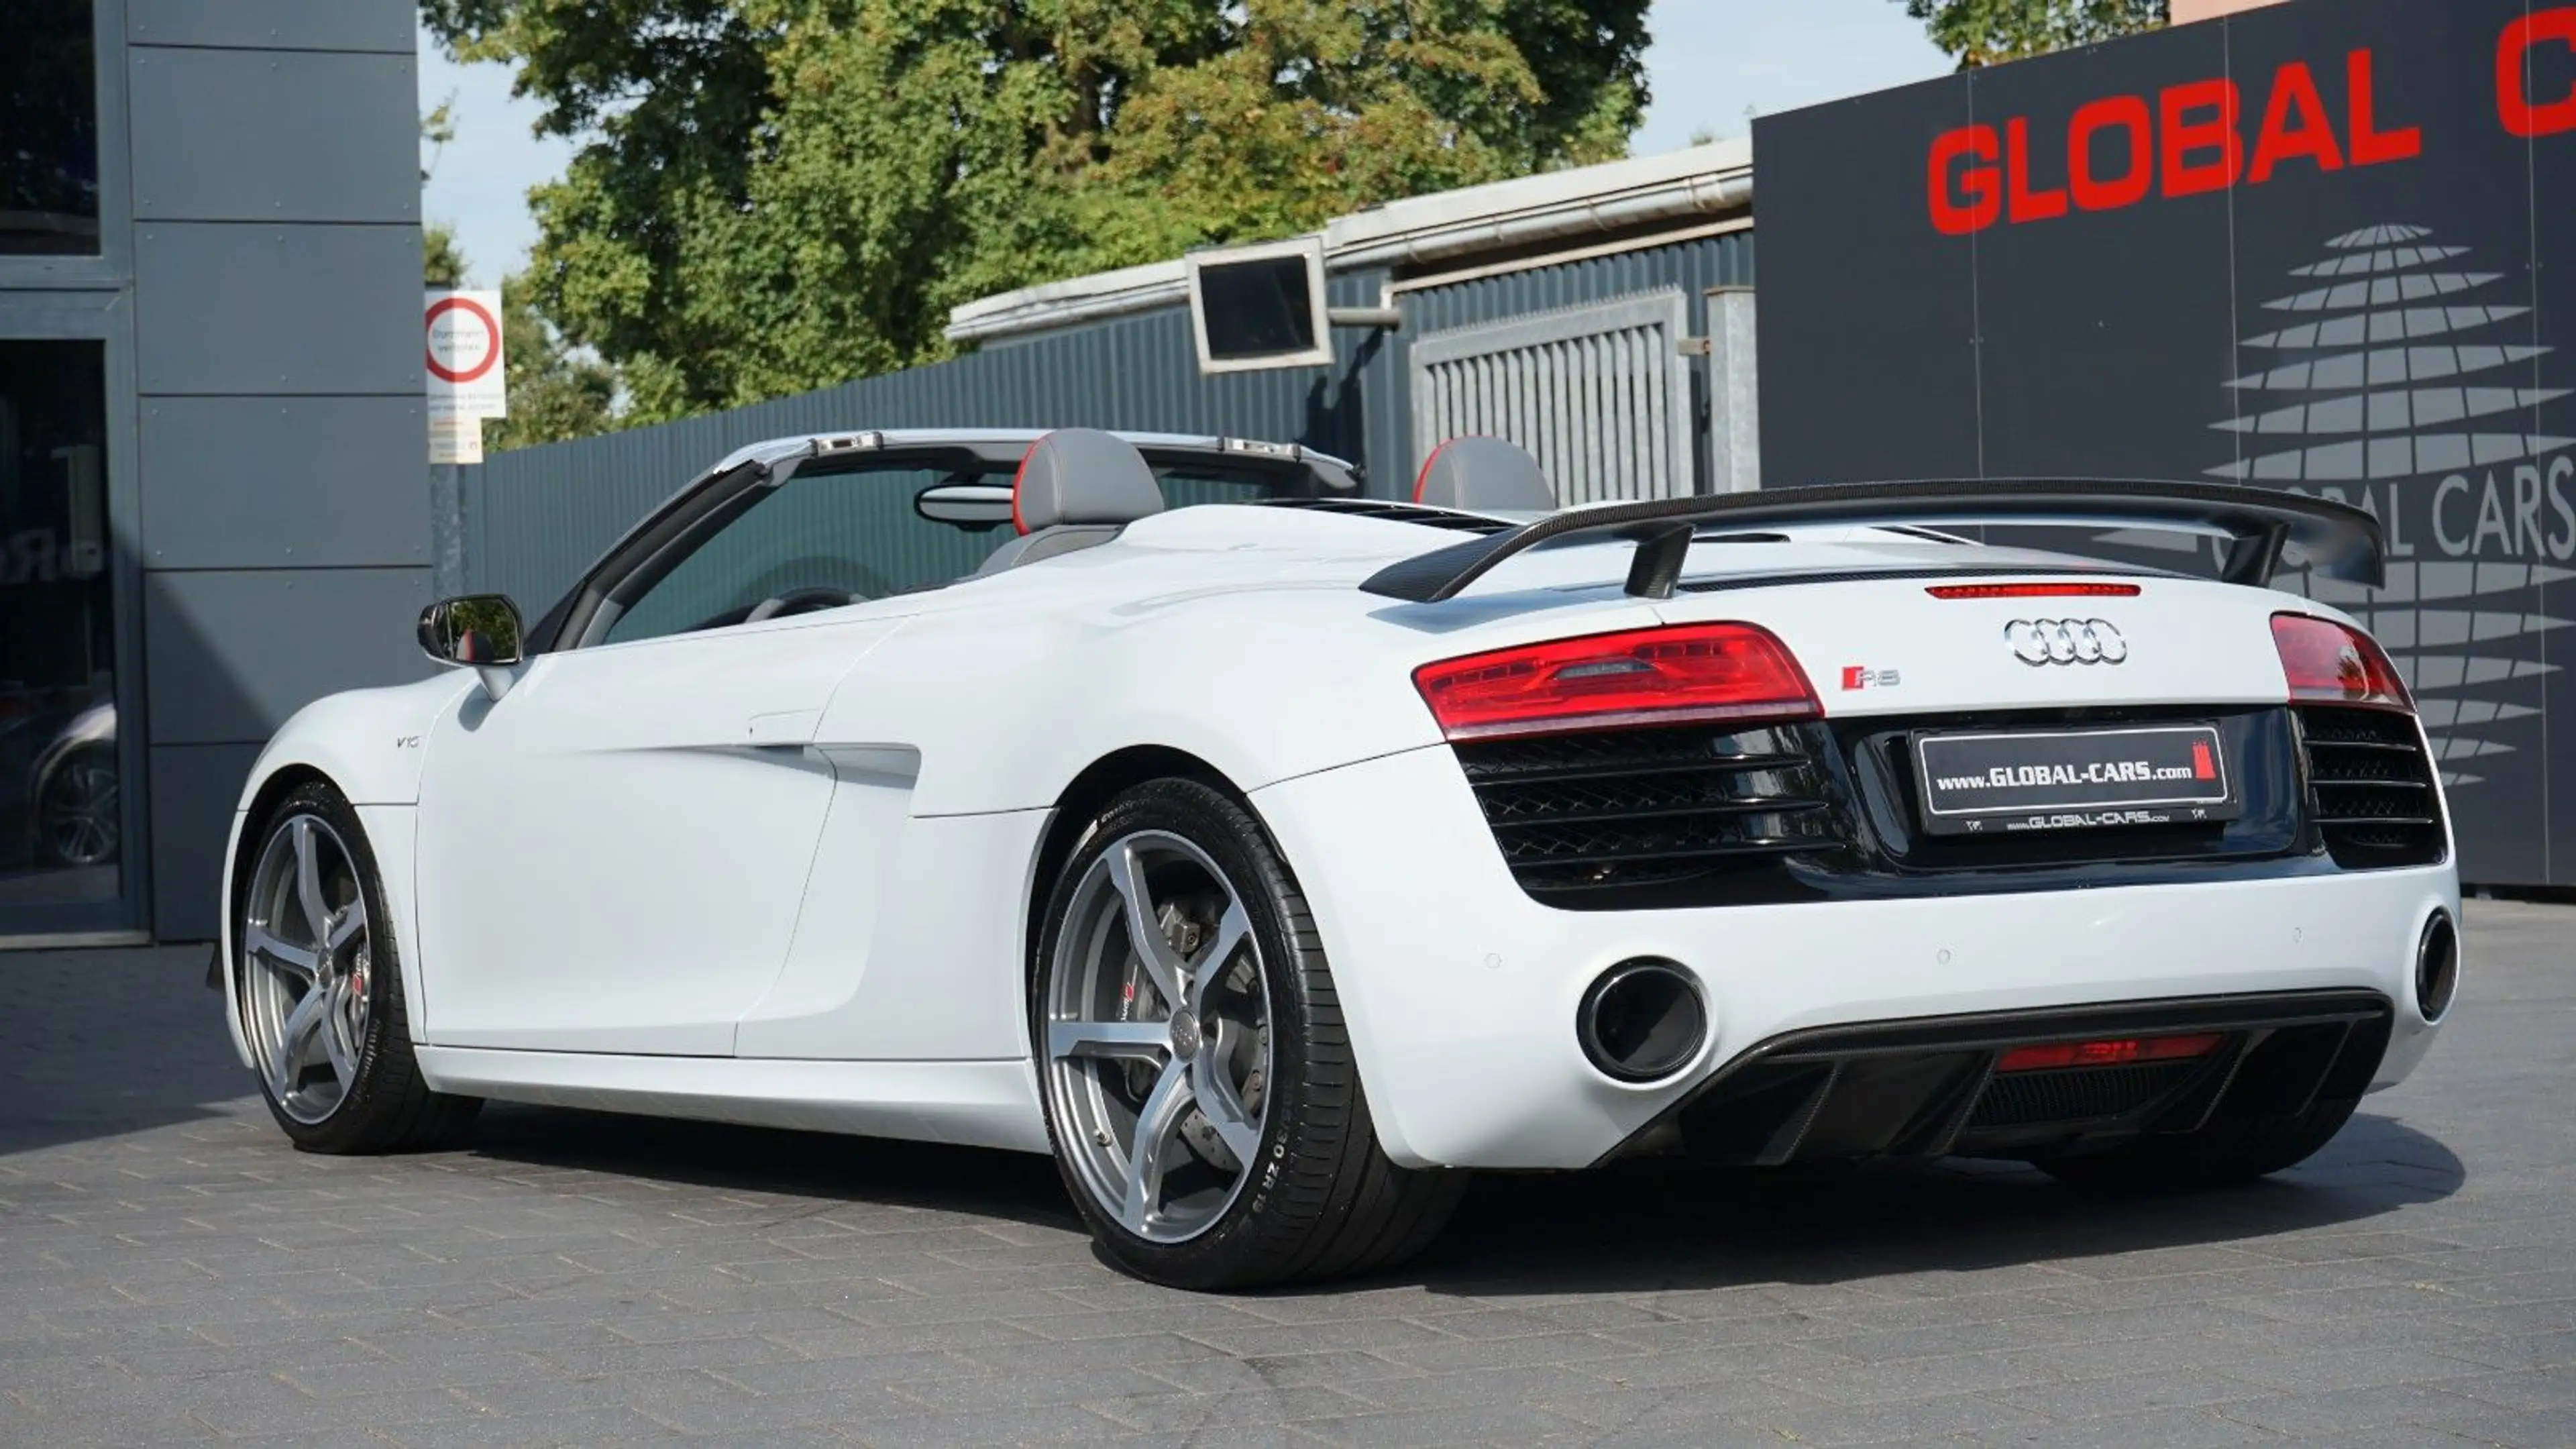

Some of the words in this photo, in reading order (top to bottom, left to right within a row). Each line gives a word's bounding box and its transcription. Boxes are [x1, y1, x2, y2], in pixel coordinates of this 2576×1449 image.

[1927, 48, 2422, 235] GLOBAL
[2432, 456, 2576, 560] CARS
[1859, 669, 1900, 687] R8
[397, 735, 421, 748] V10
[1937, 761, 2192, 790] www.GLOBAL-CARS.com
